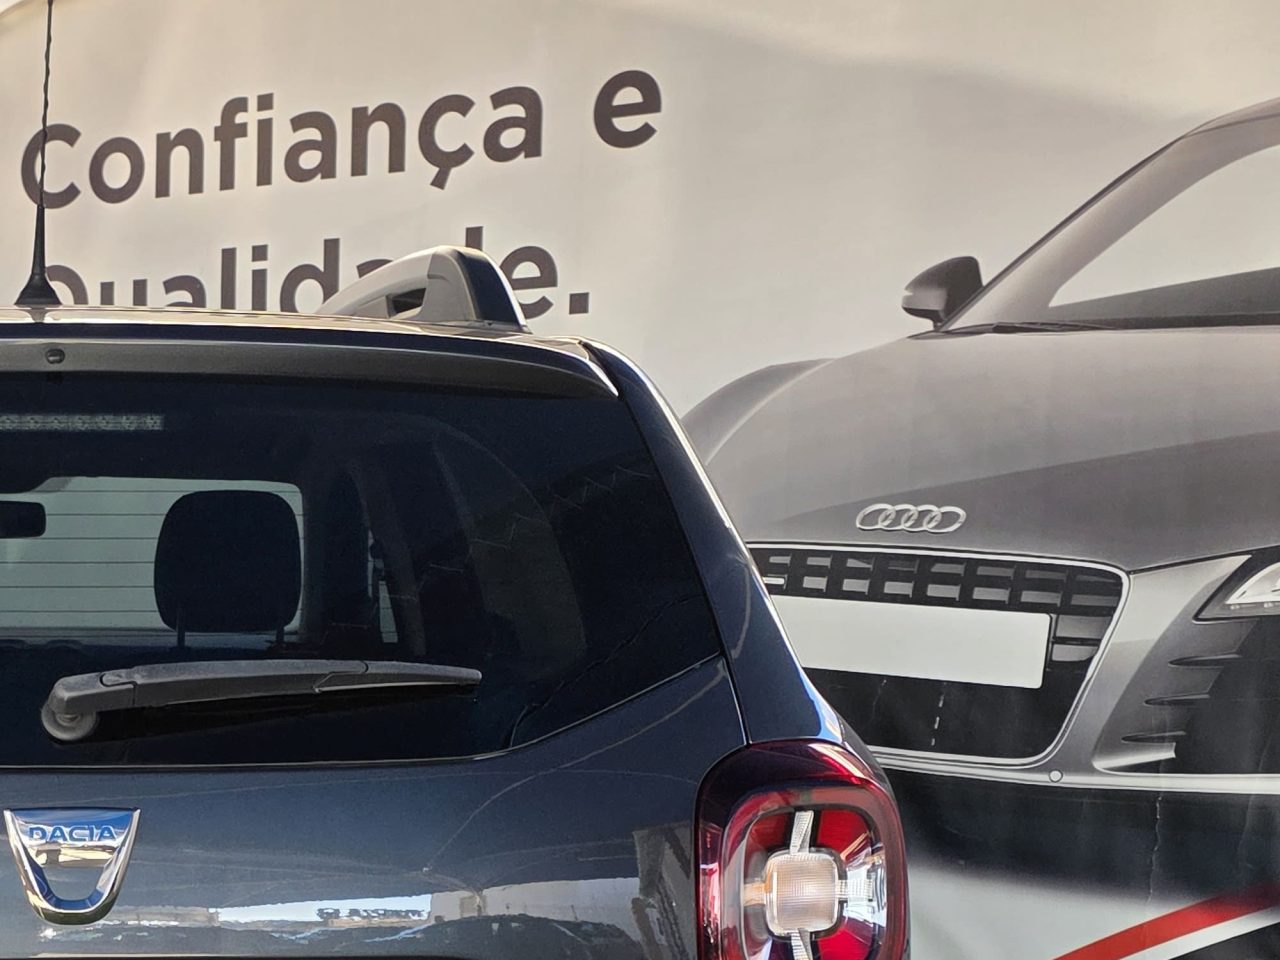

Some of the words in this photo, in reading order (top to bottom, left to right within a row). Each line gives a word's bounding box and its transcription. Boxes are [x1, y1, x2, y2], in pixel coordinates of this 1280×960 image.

[21, 85, 543, 209] Confiança
[593, 69, 662, 149] e
[28, 825, 117, 842] DACIA
